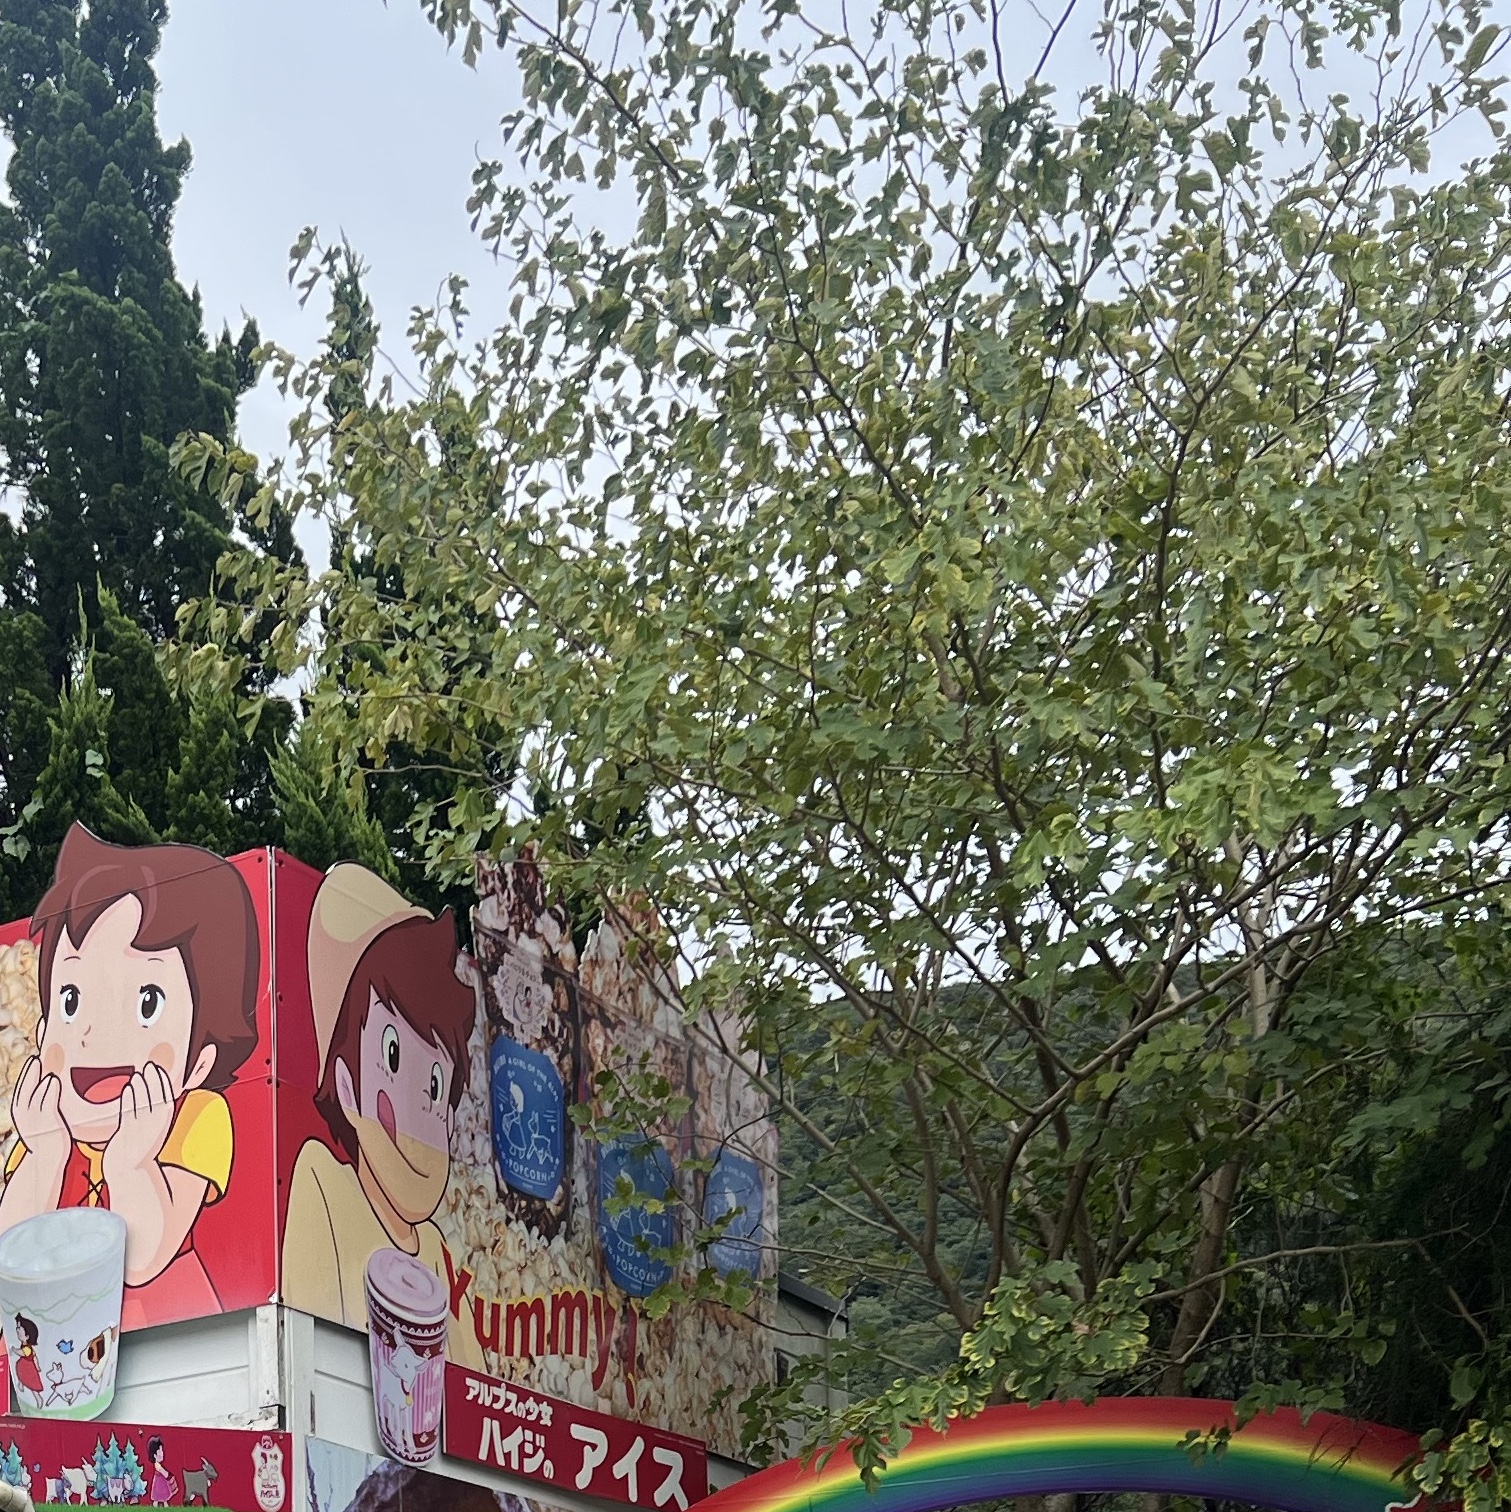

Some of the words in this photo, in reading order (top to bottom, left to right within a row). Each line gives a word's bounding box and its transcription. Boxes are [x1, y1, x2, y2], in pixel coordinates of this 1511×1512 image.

[508, 1160, 548, 1182] POPCORN
[465, 1377, 554, 1427] アルプスの少女
[478, 1416, 555, 1480] ハイジの
[569, 1422, 690, 1512] アイス
